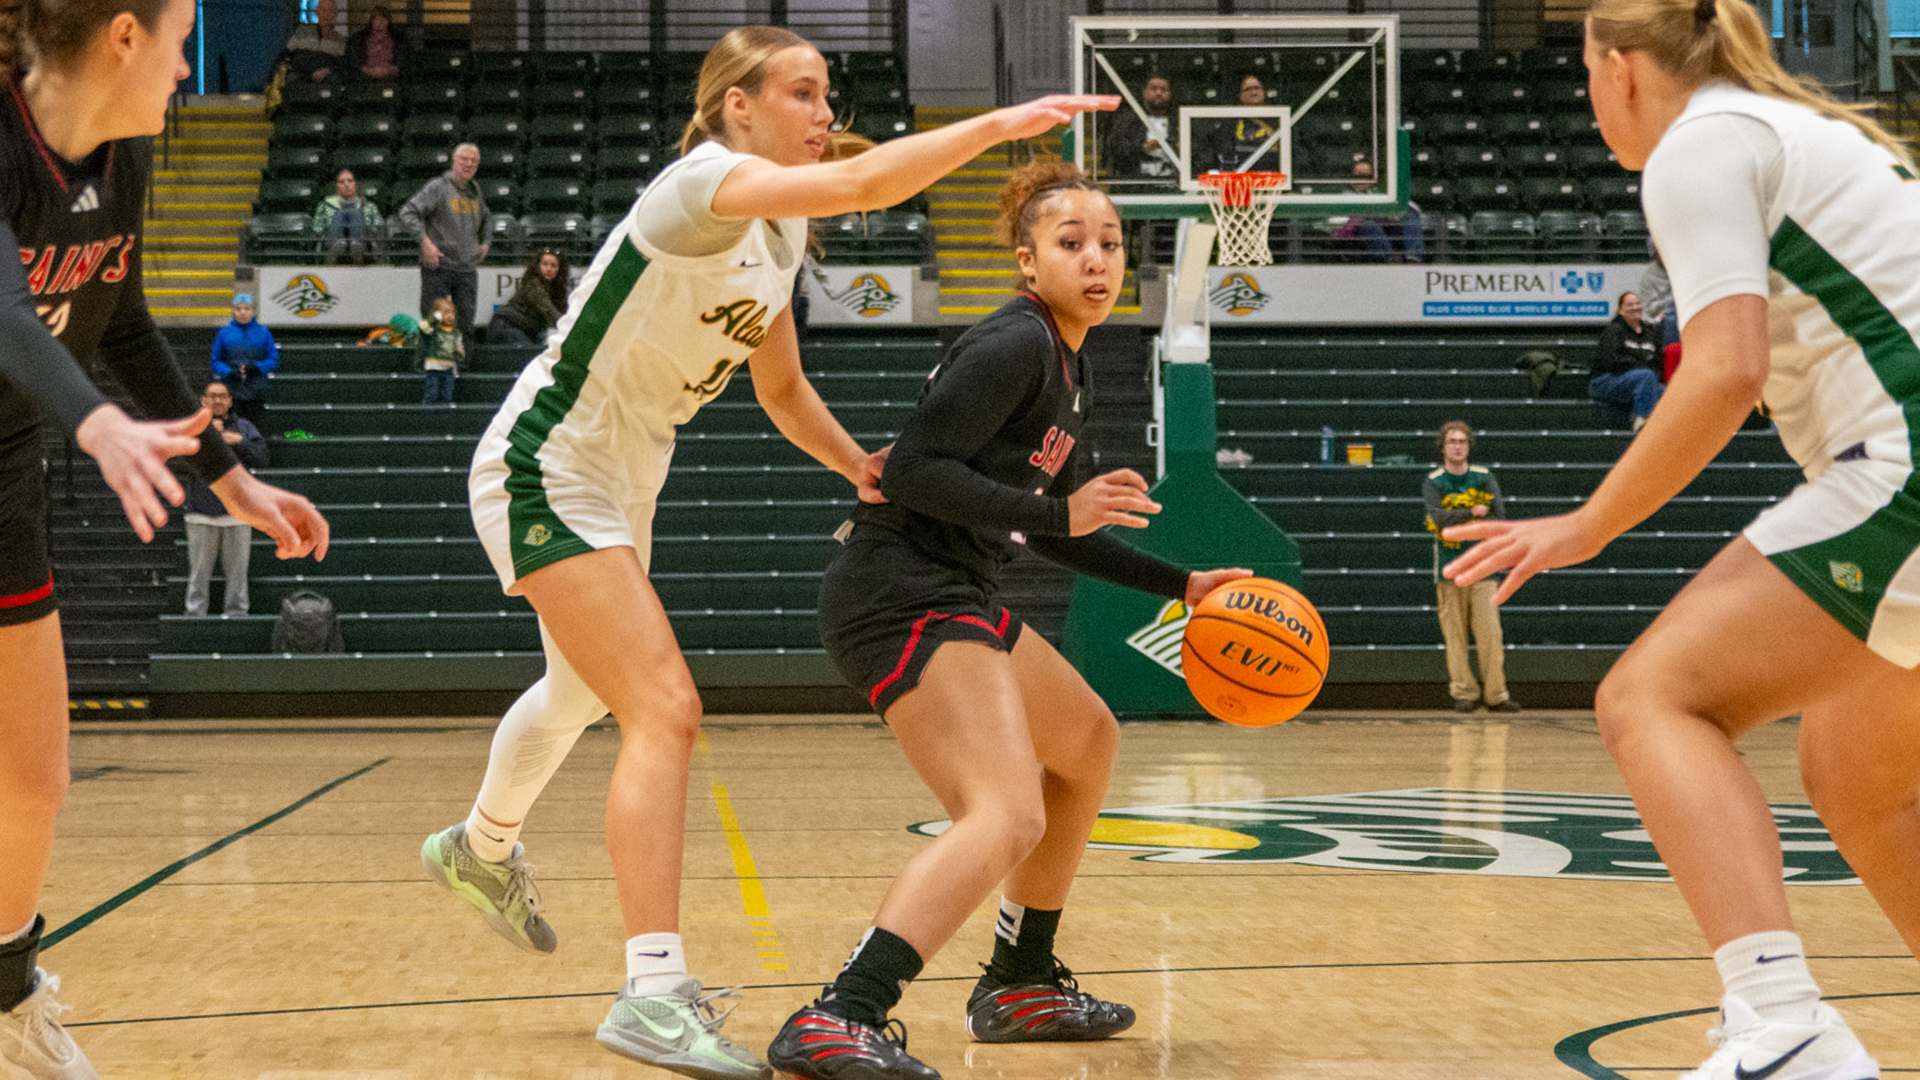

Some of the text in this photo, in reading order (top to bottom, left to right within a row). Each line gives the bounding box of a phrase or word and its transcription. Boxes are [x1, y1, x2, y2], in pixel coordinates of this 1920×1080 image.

[18, 233, 136, 295] AINTS
[1425, 271, 1545, 295] PREMERA
[700, 299, 768, 348] Ala
[1225, 592, 1314, 648] Wilson
[1220, 640, 1283, 677] EVO
